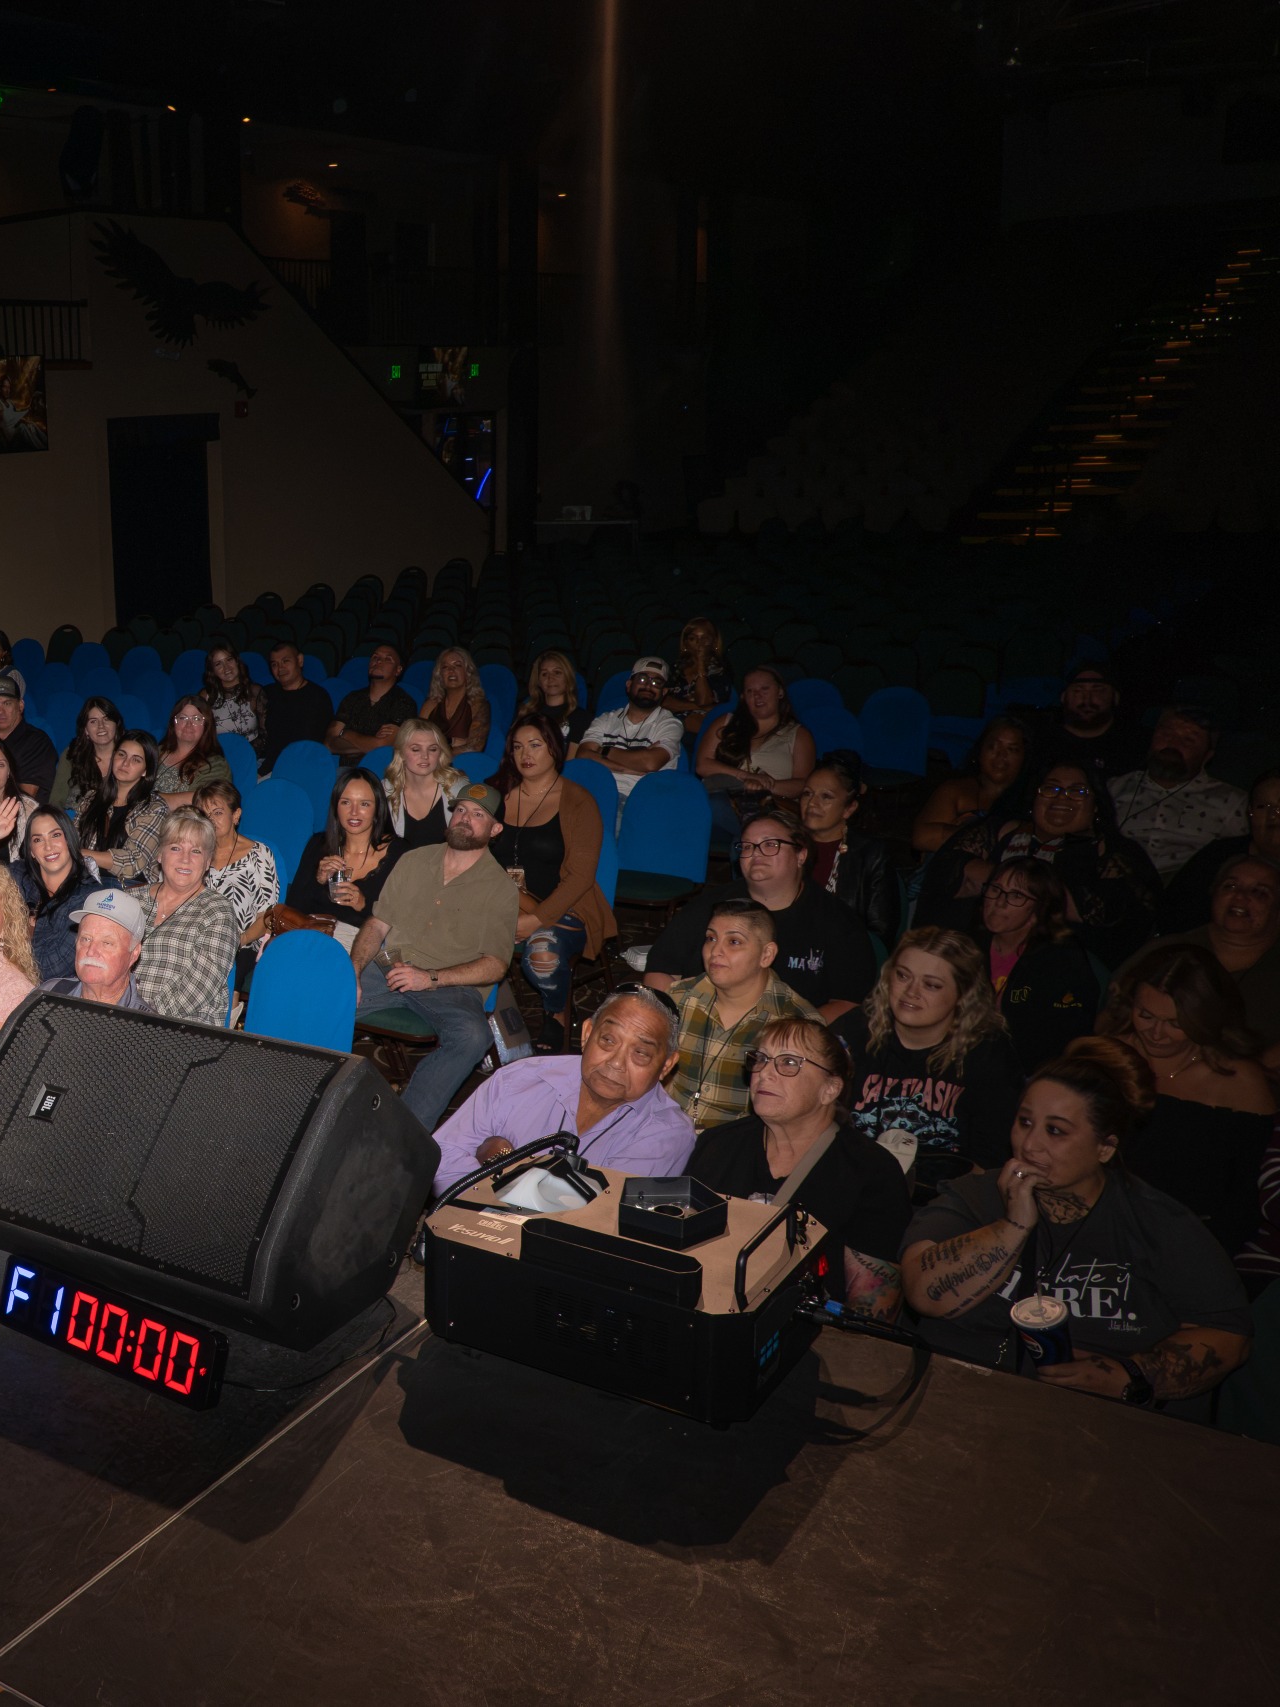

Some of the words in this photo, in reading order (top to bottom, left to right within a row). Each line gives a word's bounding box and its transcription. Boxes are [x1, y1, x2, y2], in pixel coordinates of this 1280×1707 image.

[40, 1095, 57, 1112] JBL
[1055, 1252, 1118, 1301] hate
[66, 1290, 200, 1395] 00:00
